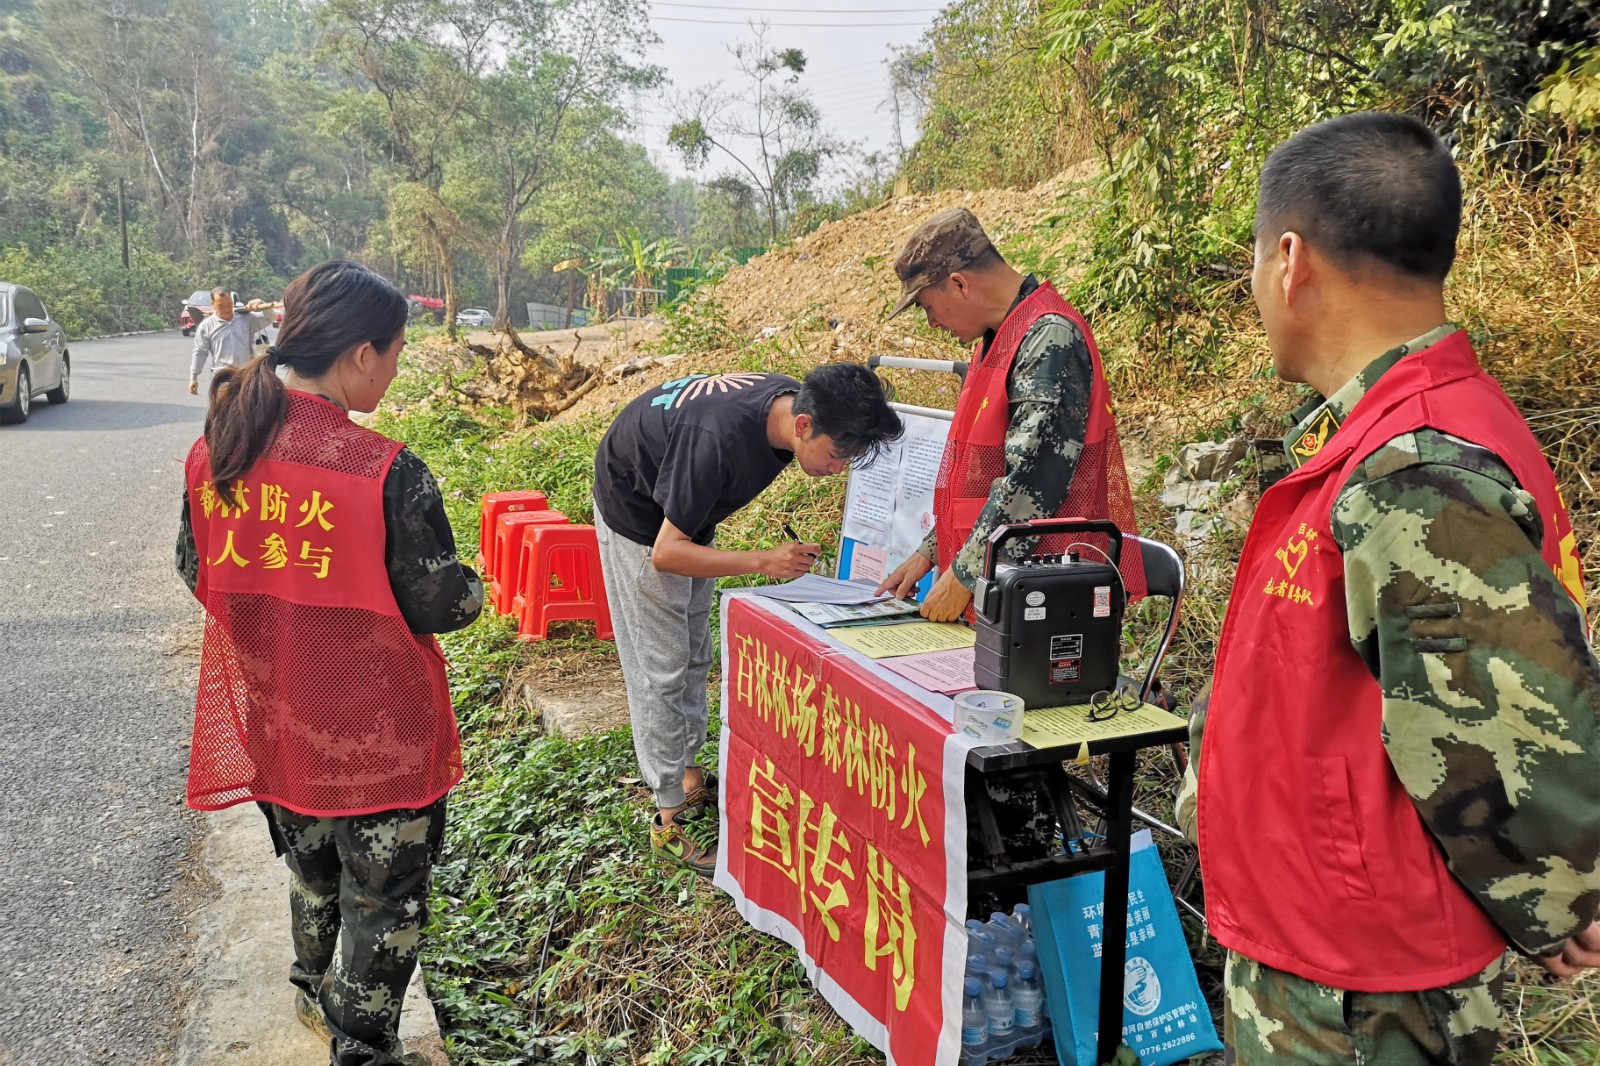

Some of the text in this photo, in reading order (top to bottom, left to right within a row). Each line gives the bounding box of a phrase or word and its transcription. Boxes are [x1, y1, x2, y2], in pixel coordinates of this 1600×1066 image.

[206, 529, 335, 579] 人参与
[743, 754, 917, 1012] 宣传岗
[1140, 1032, 1196, 1056] 0776 2622886
